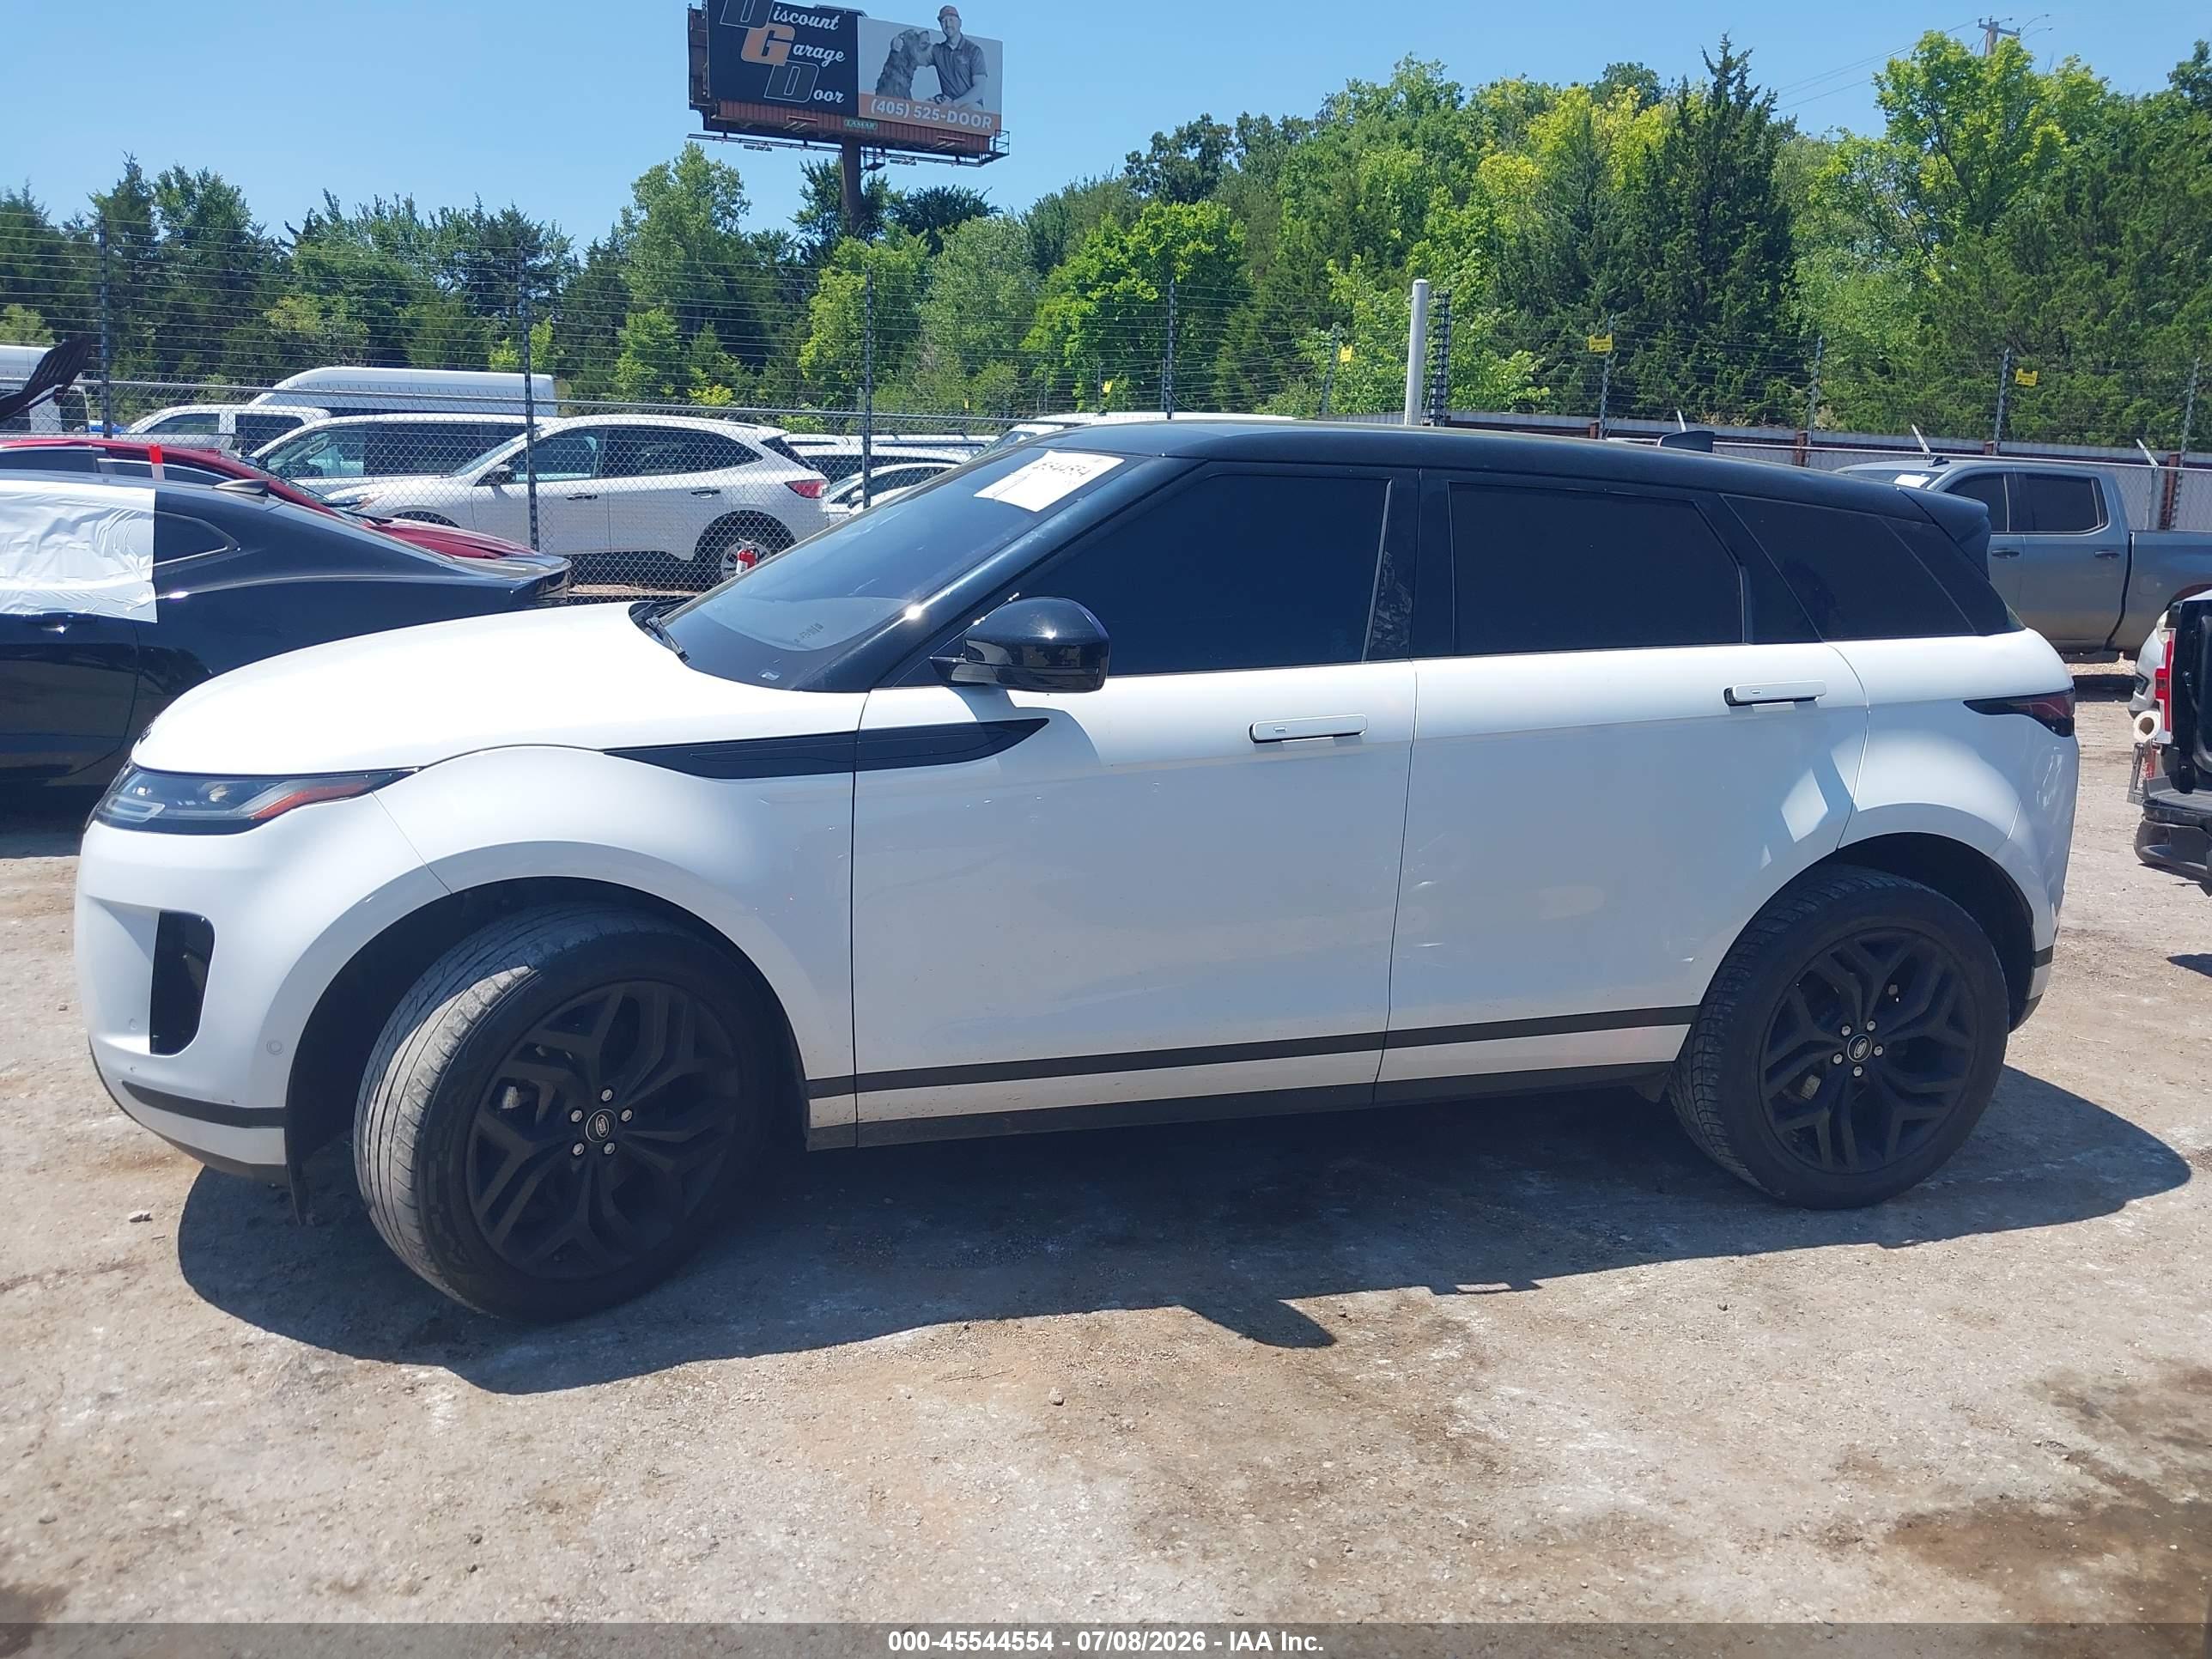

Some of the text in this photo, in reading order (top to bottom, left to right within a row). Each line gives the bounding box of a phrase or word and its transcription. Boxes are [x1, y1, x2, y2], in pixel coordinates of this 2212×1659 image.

[741, 22, 846, 67] Garage
[763, 59, 845, 103] Door
[871, 98, 993, 129] (405) 525-DOOR
